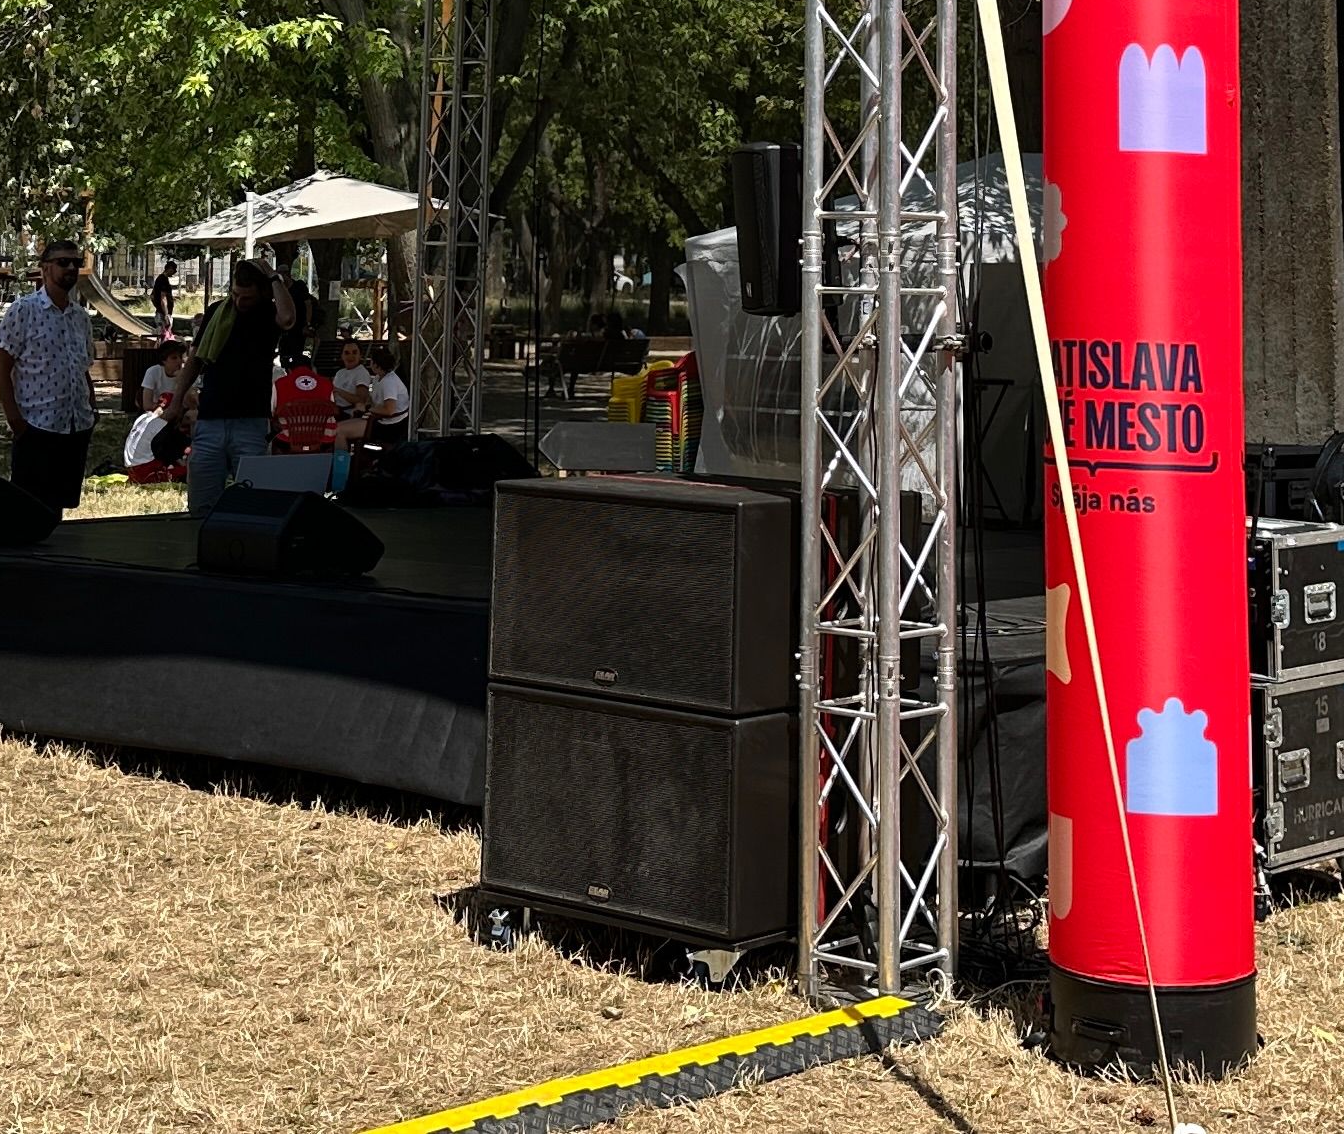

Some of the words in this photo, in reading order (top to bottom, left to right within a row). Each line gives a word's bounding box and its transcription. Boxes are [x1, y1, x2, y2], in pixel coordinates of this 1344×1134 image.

[1051, 339, 1203, 394] ATISLAVA
[1085, 399, 1204, 454] MESTO
[1109, 487, 1155, 513] nás
[1312, 630, 1327, 652] 18
[1315, 694, 1329, 717] 15
